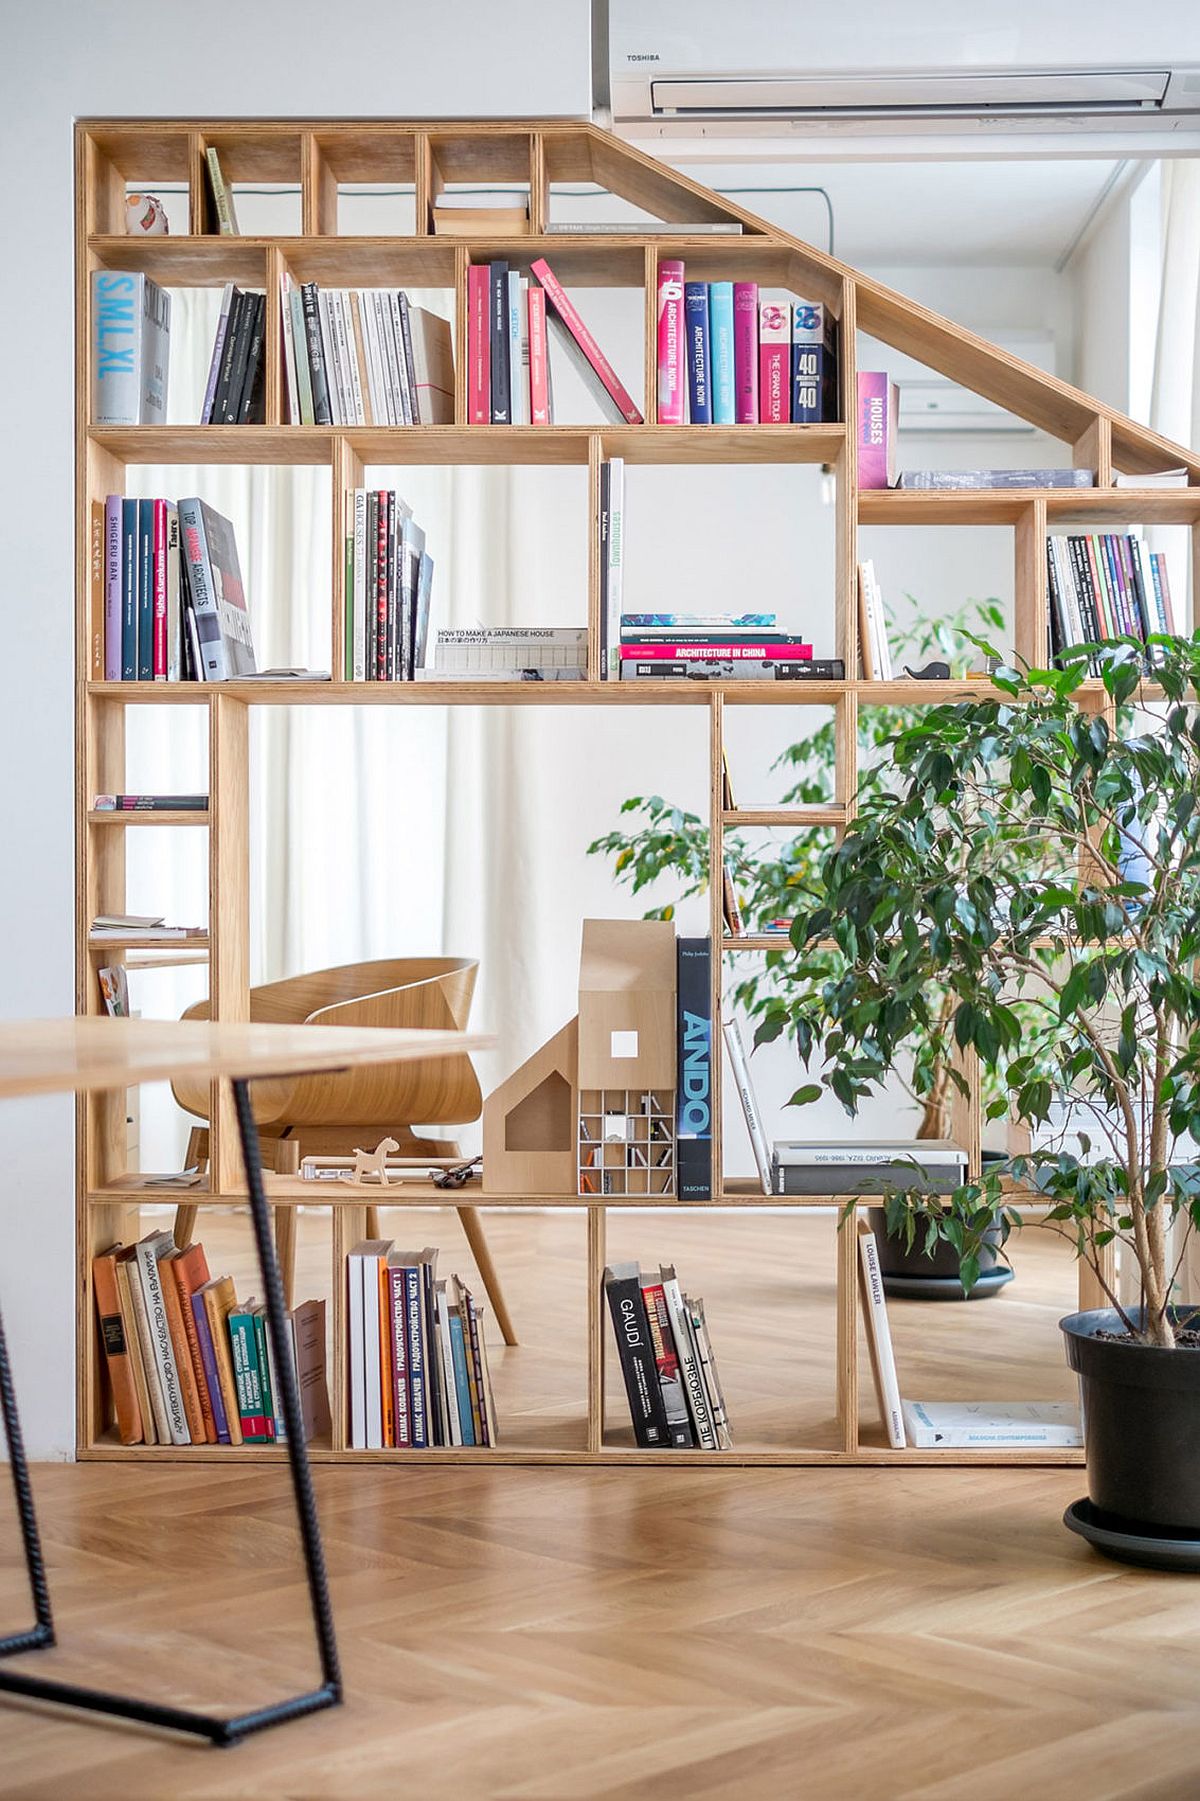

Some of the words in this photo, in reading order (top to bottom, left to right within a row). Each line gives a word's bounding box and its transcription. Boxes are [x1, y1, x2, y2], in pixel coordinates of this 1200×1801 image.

[667, 302, 677, 366] ARCHITECTURE
[694, 326, 704, 383] ARCHITECTURE
[719, 327, 729, 382] ARCHITECTURE
[772, 354, 780, 369] THE
[799, 354, 816, 375] 40
[668, 367, 676, 391] NOW!
[772, 370, 781, 398] GRAND
[696, 385, 705, 406] NOW!
[772, 399, 781, 422] TOUR
[799, 387, 816, 408] 40
[870, 398, 883, 444] HOUSES
[355, 494, 363, 508] GA
[610, 512, 621, 568] Townhouses
[156, 550, 164, 591] Kurokawa
[184, 511, 195, 525] TOP
[191, 564, 209, 606] ARCHITECTS
[156, 592, 164, 618] Kisho
[676, 648, 731, 658] ARCHITECTURE
[733, 648, 741, 657] IN
[742, 648, 766, 658] CHINA
[683, 1011, 710, 1132] ANDO
[741, 1088, 751, 1112] RICHARD
[748, 1114, 756, 1130] MEIER
[144, 1250, 159, 1290] БЪЛГАРИЯ
[866, 1244, 876, 1272] LOUISE
[152, 1291, 161, 1305] НА
[393, 1280, 402, 1298] ЧАСТ
[409, 1280, 418, 1298] ЧАСТ
[654, 1290, 663, 1298] LE
[870, 1274, 881, 1305] LAWLER
[620, 1299, 644, 1348] GAUDÍ
[656, 1299, 668, 1327] CORBUSIER
[153, 1307, 172, 1360] НАСЛЕДСТВО
[394, 1300, 405, 1371] ГРАДОУСТРОЙСТВО
[409, 1300, 421, 1371] ГРАДОУСТРОЙСТВО
[650, 1322, 665, 1360] ARCHITECTURE
[162, 1362, 184, 1434] АРХИТЕКТУРНОТО
[397, 1378, 406, 1412] КОВАЧЕВ
[413, 1378, 422, 1412] КОВАЧЕВ
[684, 1357, 708, 1424] КОРБЮЗЬЕ
[399, 1414, 408, 1442] АТАНАС
[414, 1414, 423, 1442] АТАНАС
